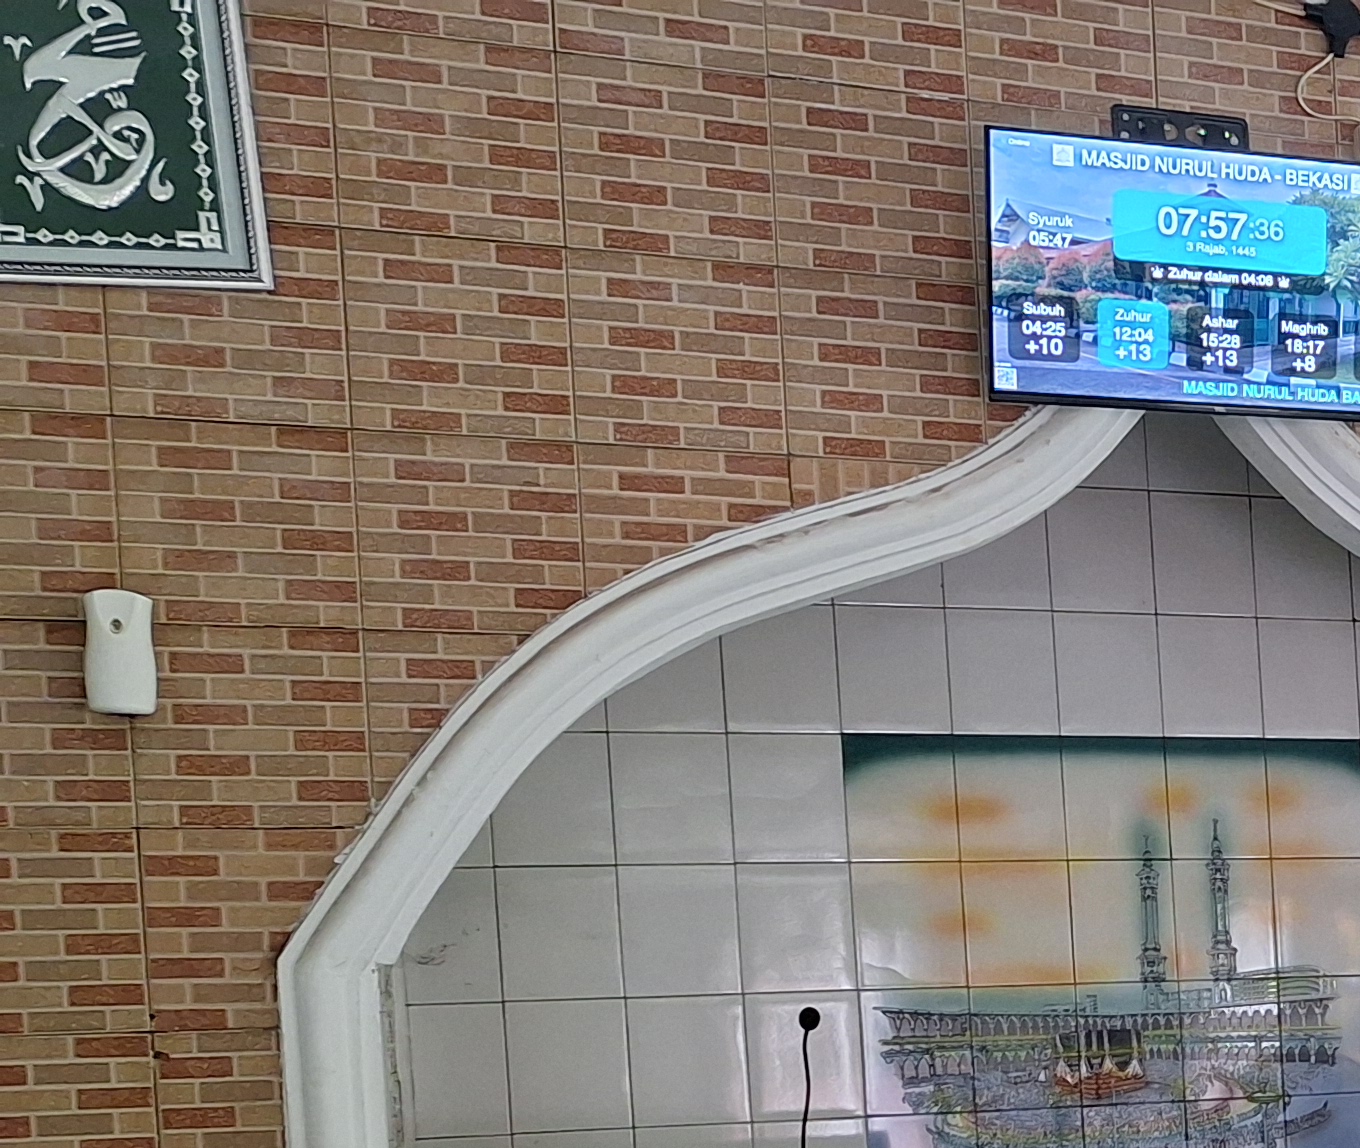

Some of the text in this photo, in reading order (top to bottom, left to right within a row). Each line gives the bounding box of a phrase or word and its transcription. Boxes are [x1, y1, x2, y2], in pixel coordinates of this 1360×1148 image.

[1081, 149, 1150, 171] MASJID
[1154, 160, 1218, 178] NURUL
[1221, 164, 1272, 184] HUDA
[1286, 169, 1348, 191] BEKASI
[1028, 211, 1074, 229] Syuruk
[1157, 205, 1285, 242] 07:57:36
[1028, 230, 1073, 249] 05:47
[1186, 241, 1257, 257] 3 Rajab, 1445
[1167, 266, 1202, 281] Zuhur
[1204, 270, 1239, 284] dalam
[1022, 301, 1065, 317] Subuh
[1115, 308, 1152, 323] Zuhur
[1021, 320, 1066, 337] 04:25
[1202, 315, 1239, 329] Ashar
[1281, 319, 1329, 337] Maghrib
[1113, 326, 1154, 342] 12:04
[1200, 333, 1241, 349] 15:28
[1024, 338, 1063, 355] +10
[1115, 344, 1151, 361] +13
[1285, 339, 1325, 355] 18:17
[1202, 350, 1238, 367] +13
[1292, 356, 1316, 373] +8
[1183, 379, 1238, 397] MASJID
[1242, 384, 1294, 400] NURUL
[1297, 387, 1339, 403] HUDA
